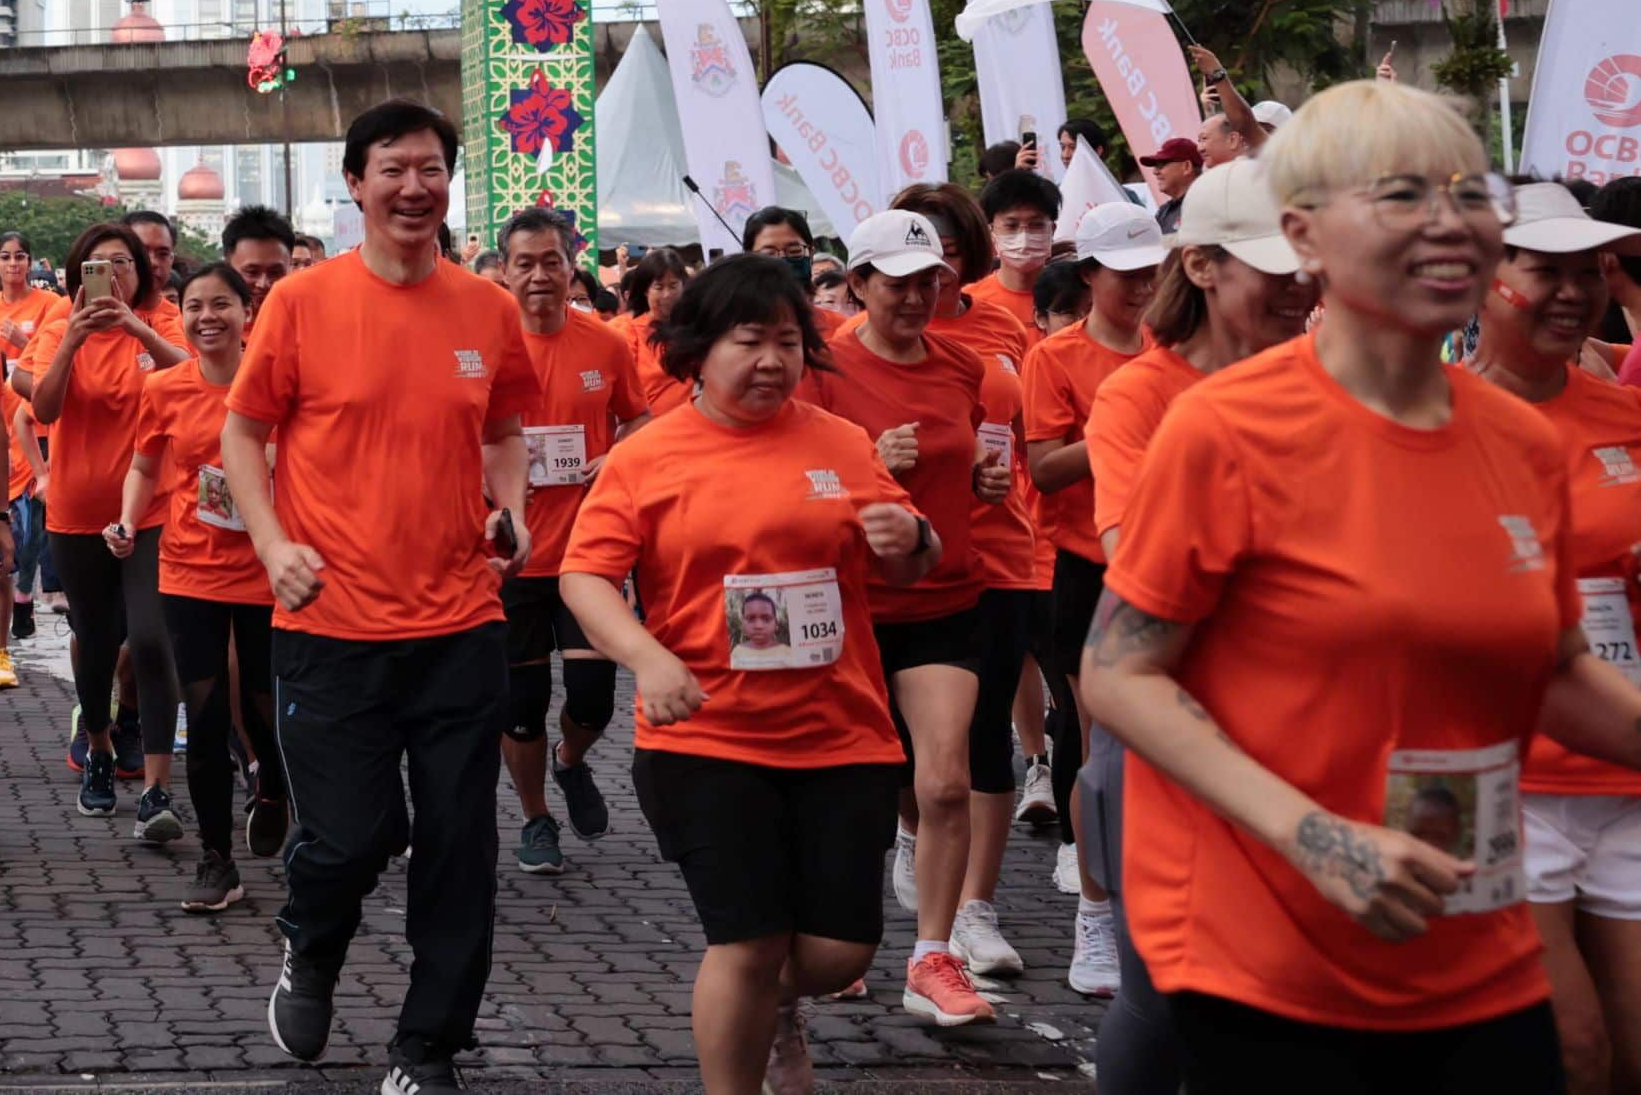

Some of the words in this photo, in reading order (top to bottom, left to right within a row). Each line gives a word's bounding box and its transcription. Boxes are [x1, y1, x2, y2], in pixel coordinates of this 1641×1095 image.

[460, 361, 483, 372] RUN
[554, 457, 581, 468] 1939
[812, 481, 841, 493] RUN
[800, 620, 838, 640] 1034
